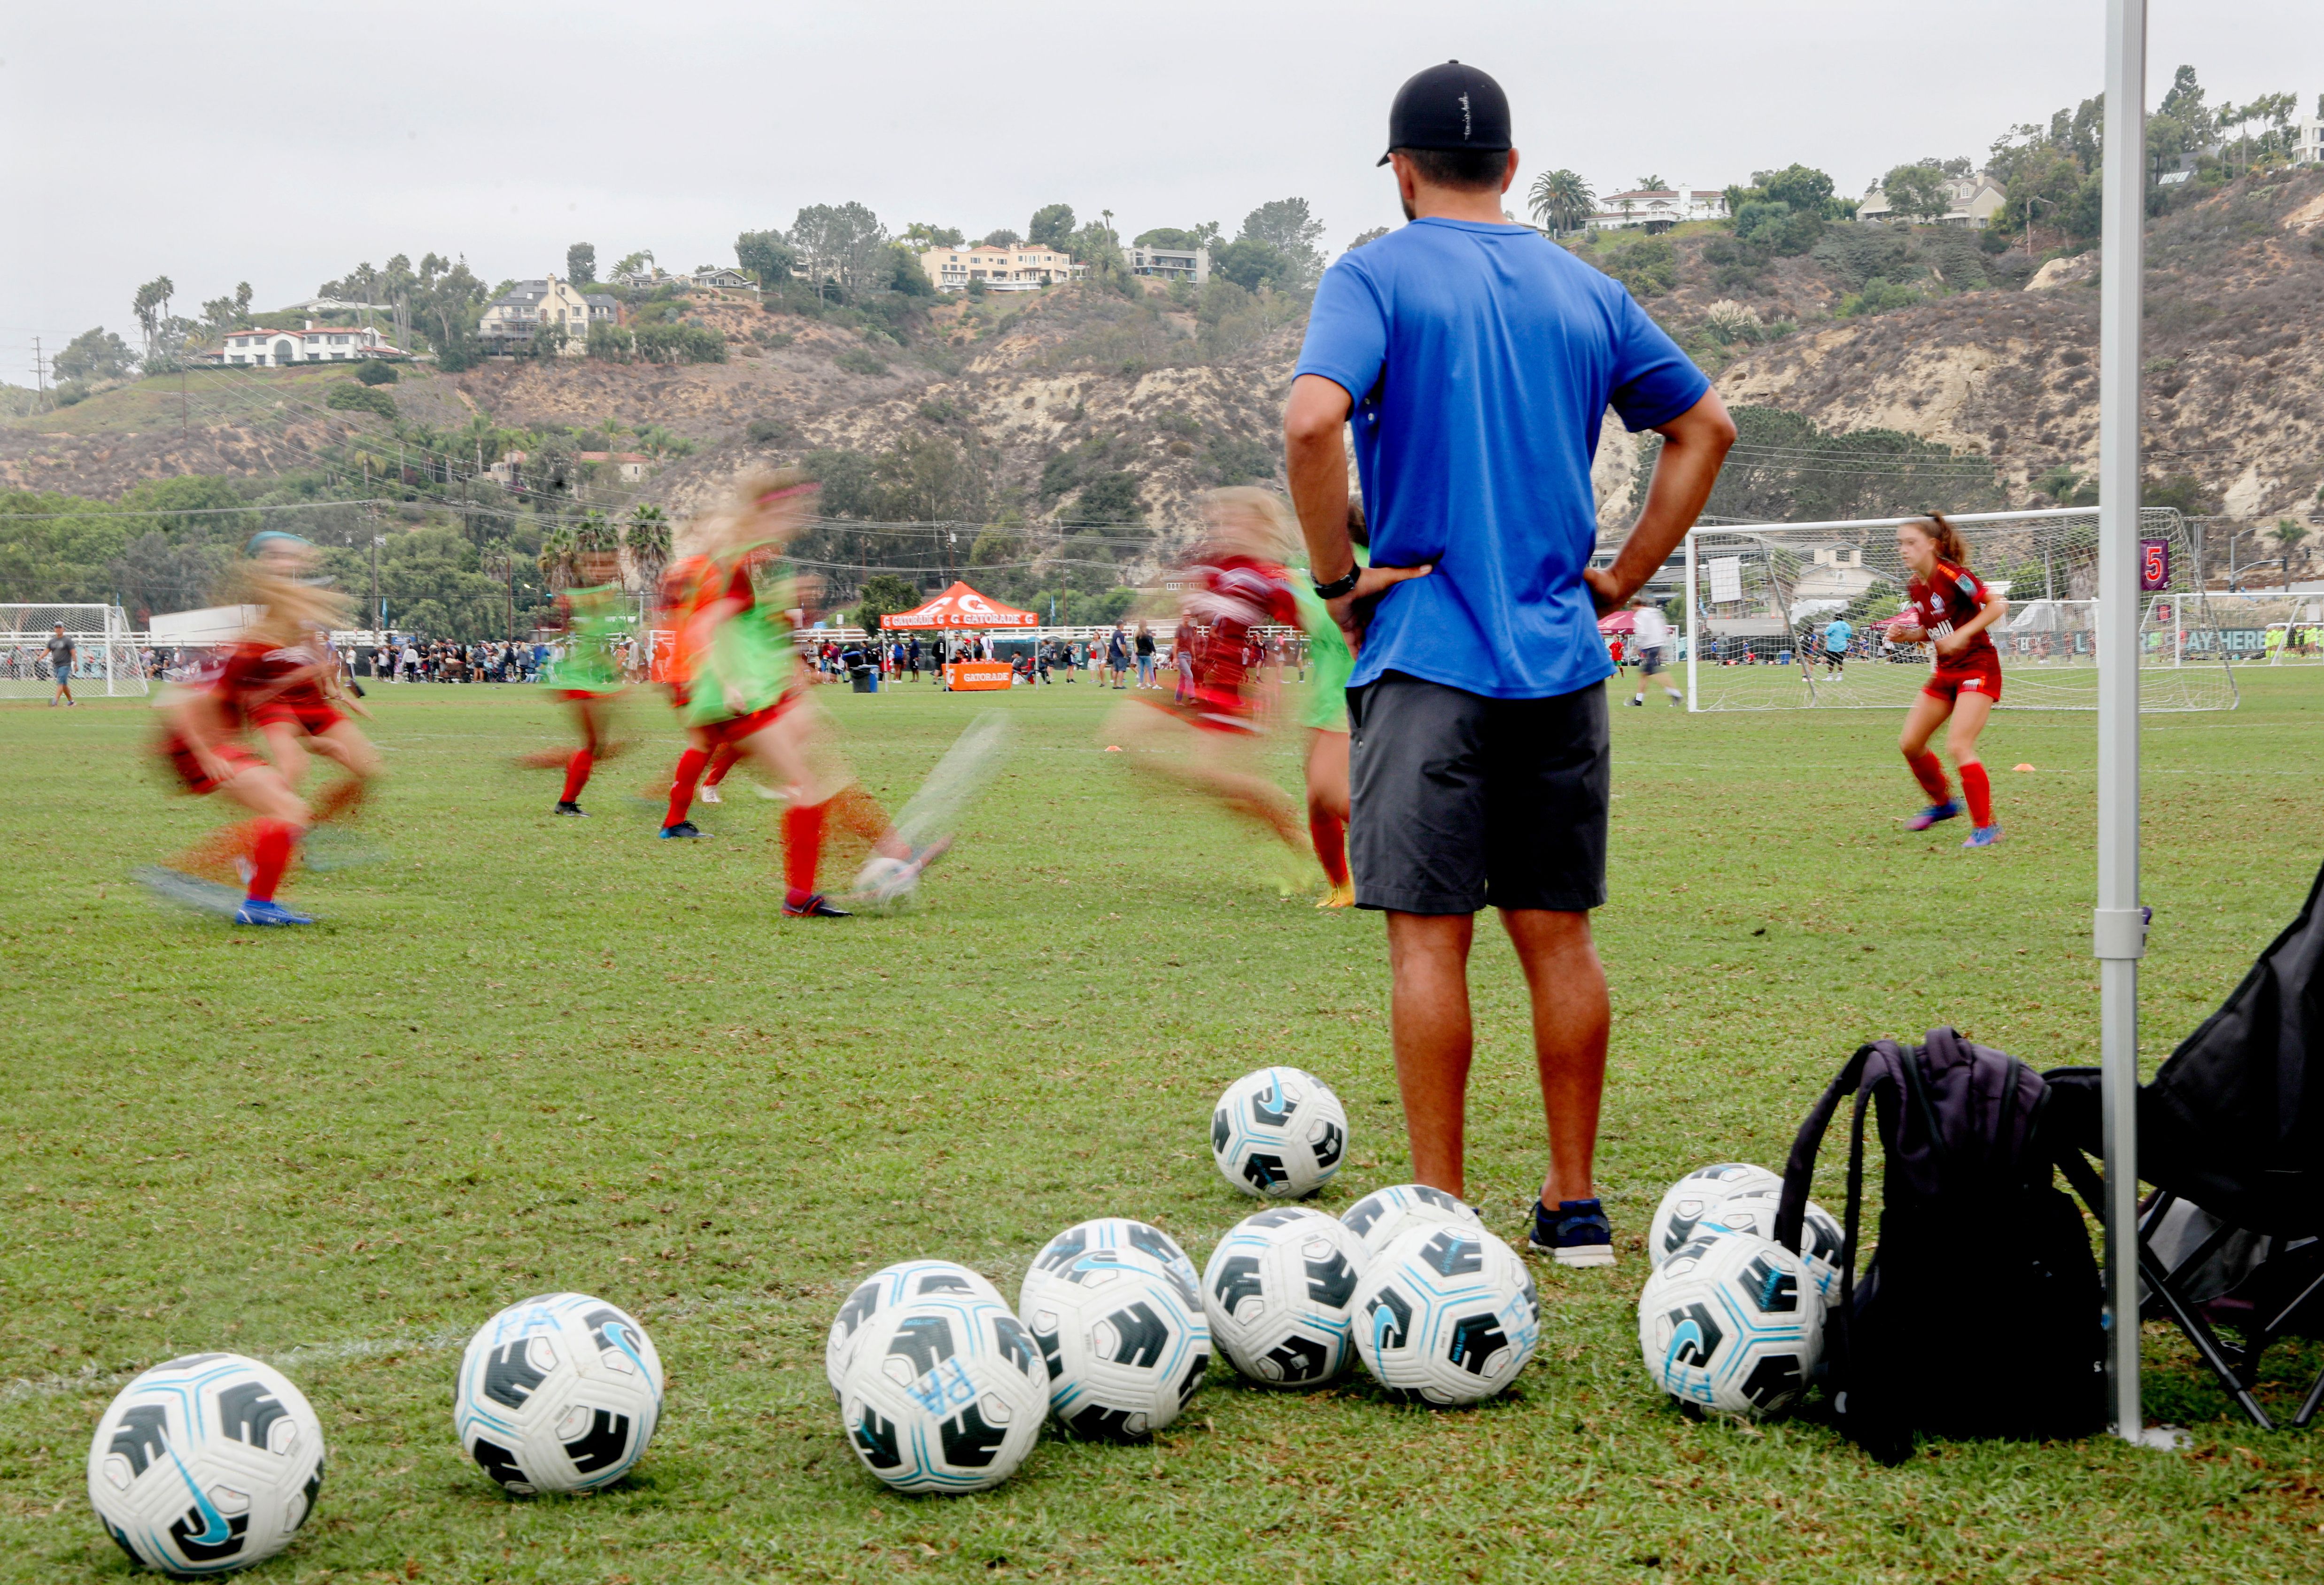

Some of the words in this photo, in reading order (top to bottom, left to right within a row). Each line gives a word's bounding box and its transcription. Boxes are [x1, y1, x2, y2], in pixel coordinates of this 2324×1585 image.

[2146, 547, 2163, 581] 5
[883, 617, 890, 626] G
[892, 615, 935, 626] GATORADE
[950, 614, 960, 624] G
[963, 614, 1020, 624] GATORADE
[2219, 630, 2268, 650] HERE
[964, 673, 1009, 681] GATORADE
[906, 1357, 976, 1415] PA
